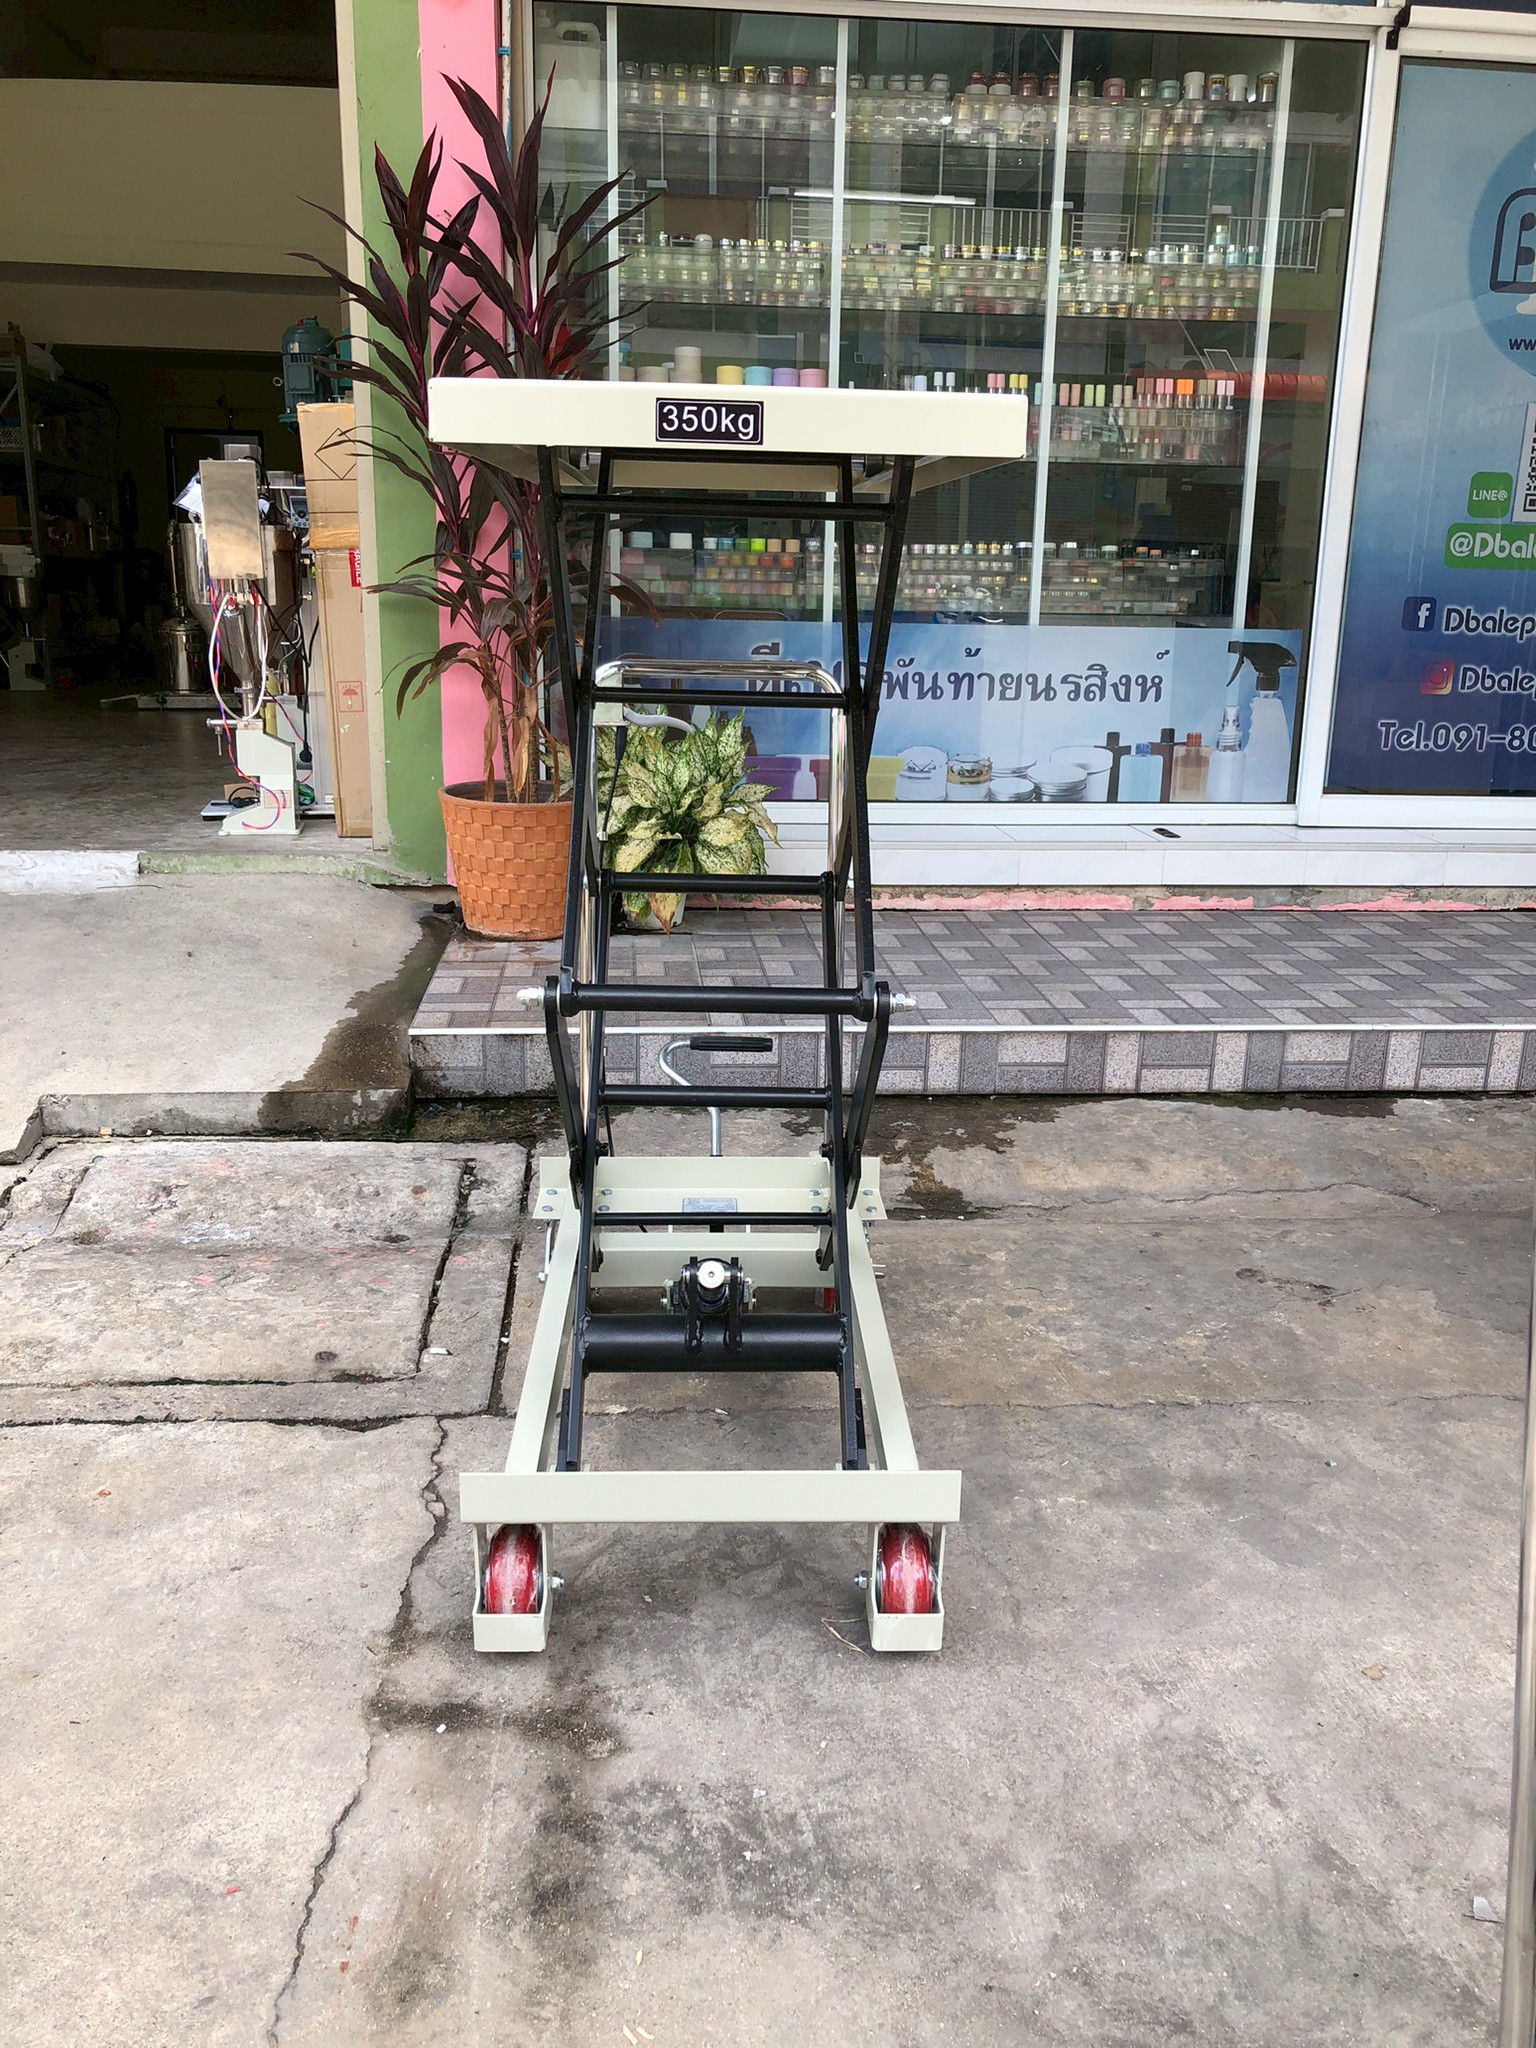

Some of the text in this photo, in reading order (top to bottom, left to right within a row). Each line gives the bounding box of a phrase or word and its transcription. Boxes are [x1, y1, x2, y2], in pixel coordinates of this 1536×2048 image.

[661, 404, 755, 440] 350kg
[1472, 489, 1508, 502] LINE@
[1449, 531, 1536, 559] @Dbal
[1443, 607, 1536, 641] Dbalep
[1460, 666, 1536, 699] Dbale
